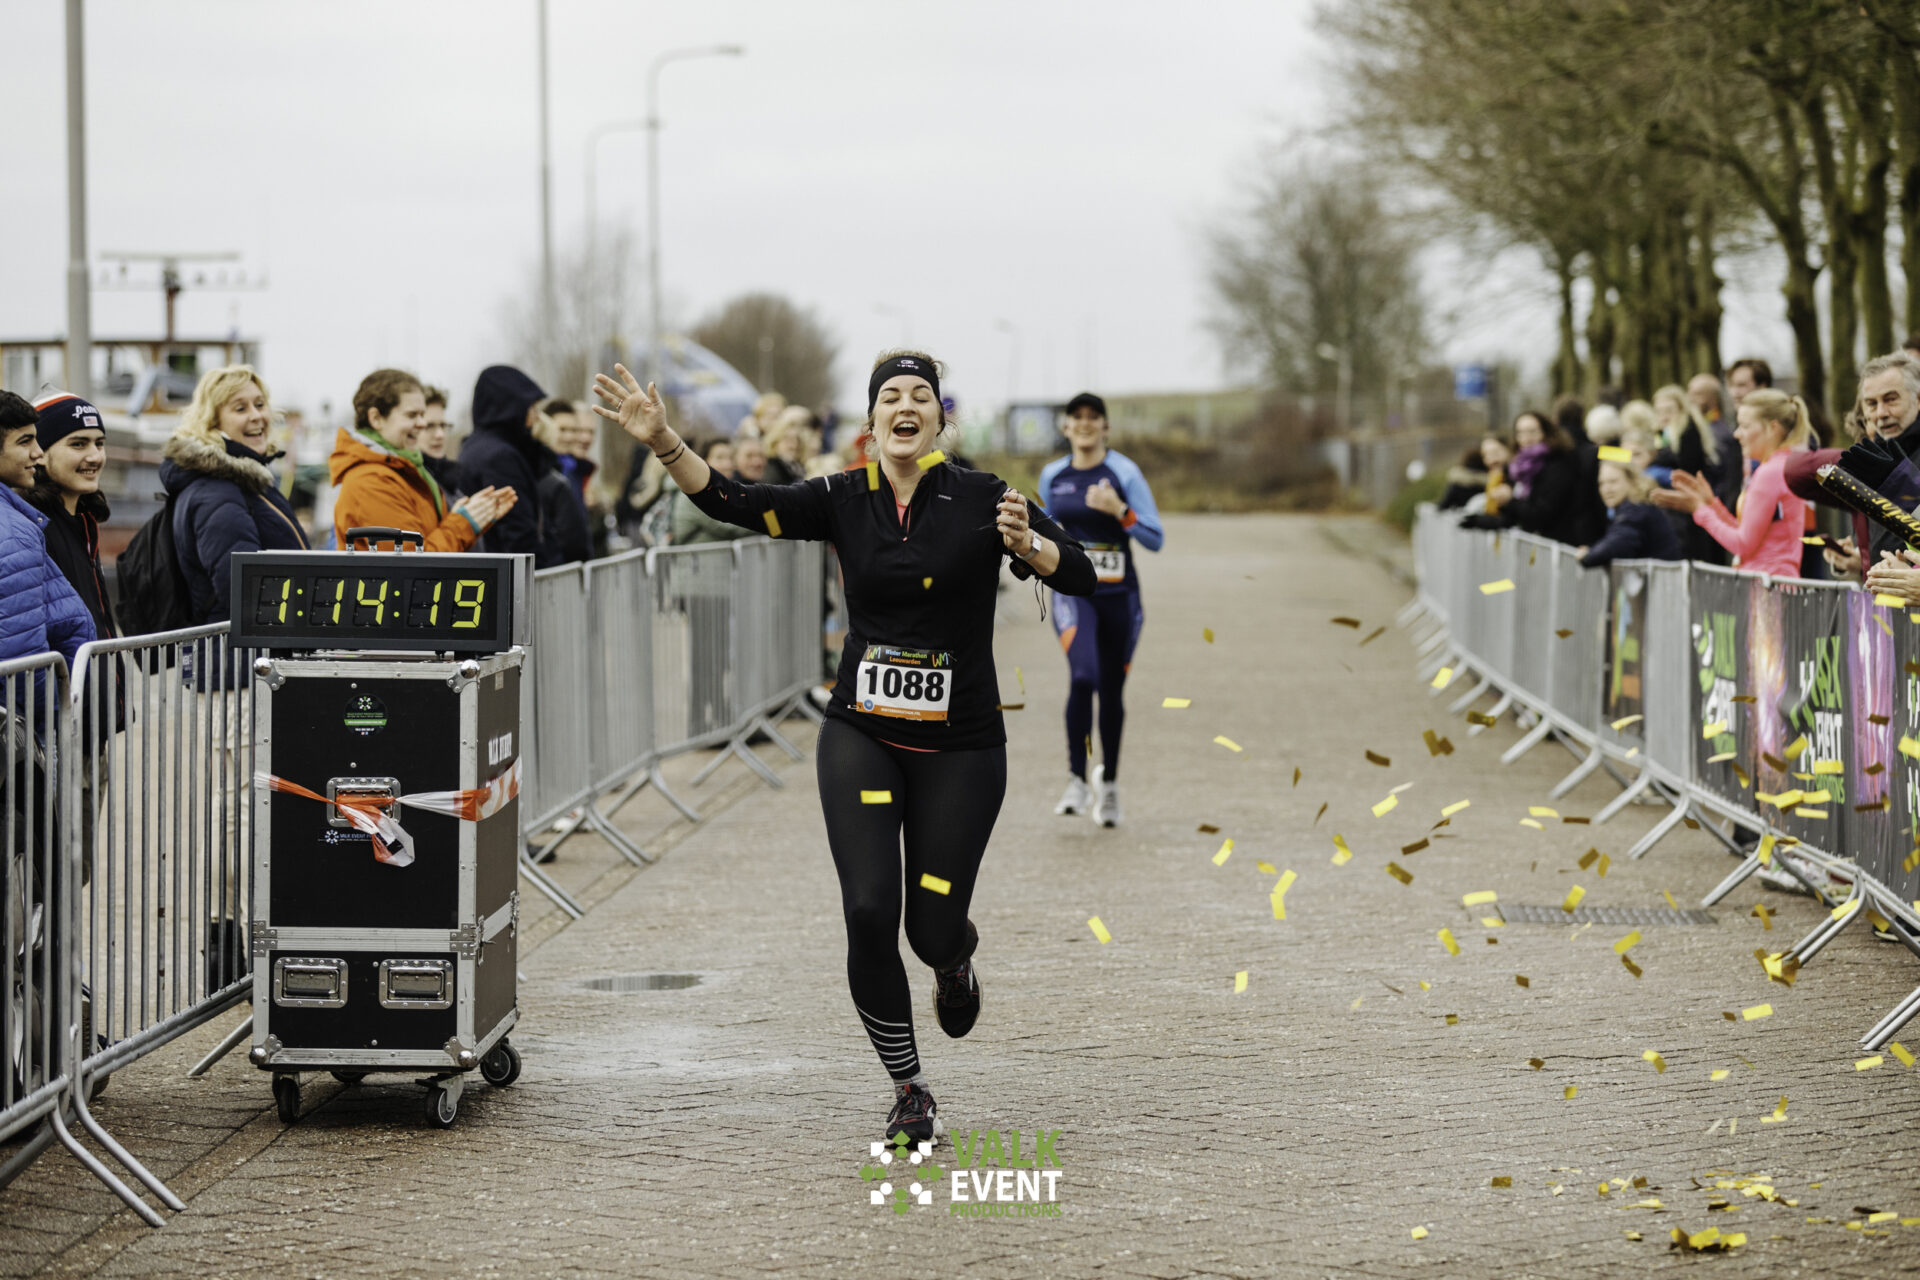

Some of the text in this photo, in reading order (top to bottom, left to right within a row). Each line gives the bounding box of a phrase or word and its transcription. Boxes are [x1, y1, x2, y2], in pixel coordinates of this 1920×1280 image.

[277, 579, 486, 628] 1:14:19
[885, 648, 928, 659] Winter Marathon
[889, 656, 921, 665] Leeuwarden
[864, 665, 945, 702] 1088
